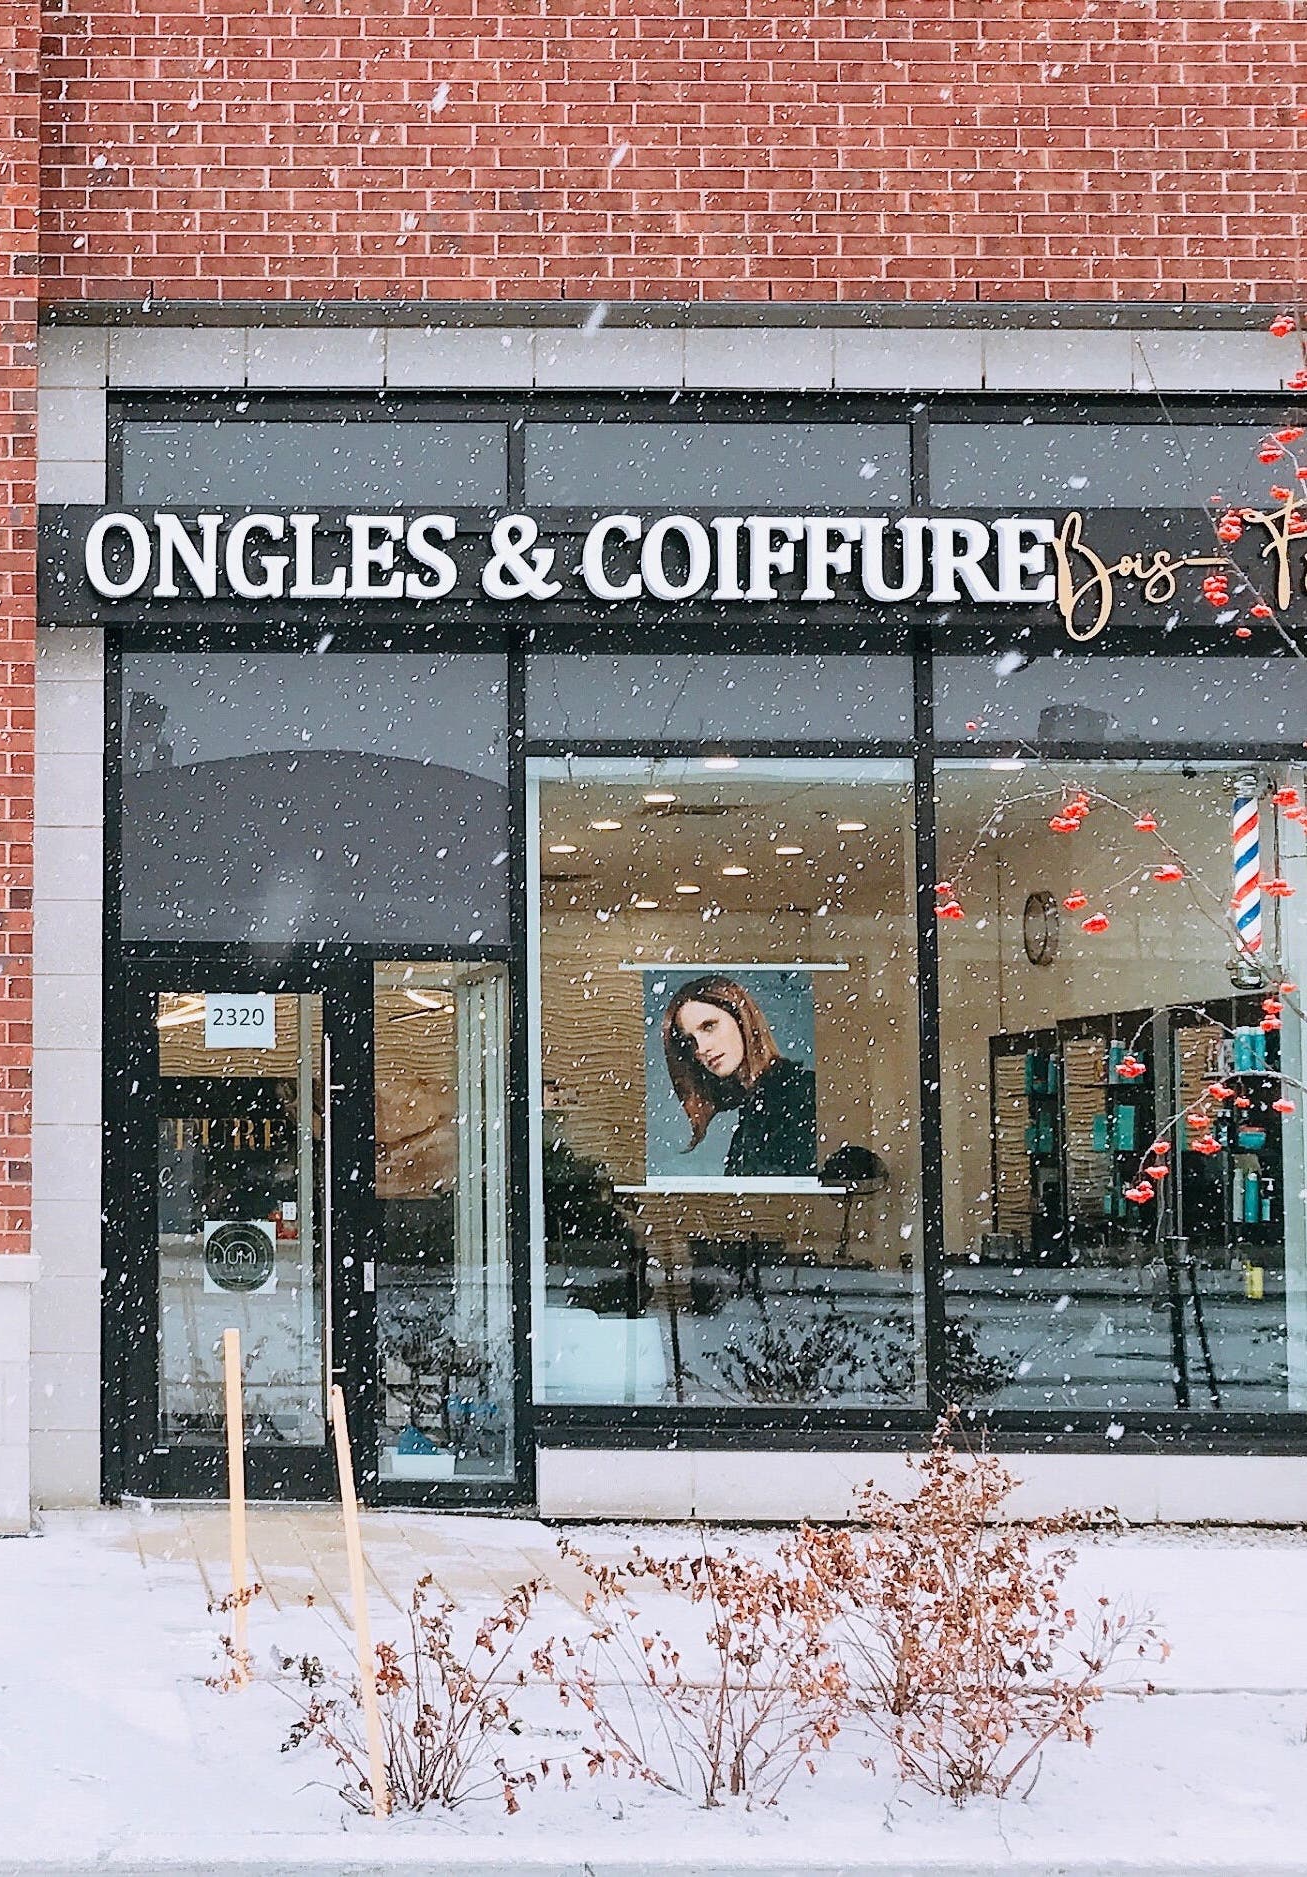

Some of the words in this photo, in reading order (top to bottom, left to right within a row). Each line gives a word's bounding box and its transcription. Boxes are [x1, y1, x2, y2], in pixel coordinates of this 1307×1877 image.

[85, 512, 459, 600] ONGLES
[482, 513, 563, 600] &
[582, 515, 1056, 602] COIFFURE
[213, 1008, 265, 1026] 2320
